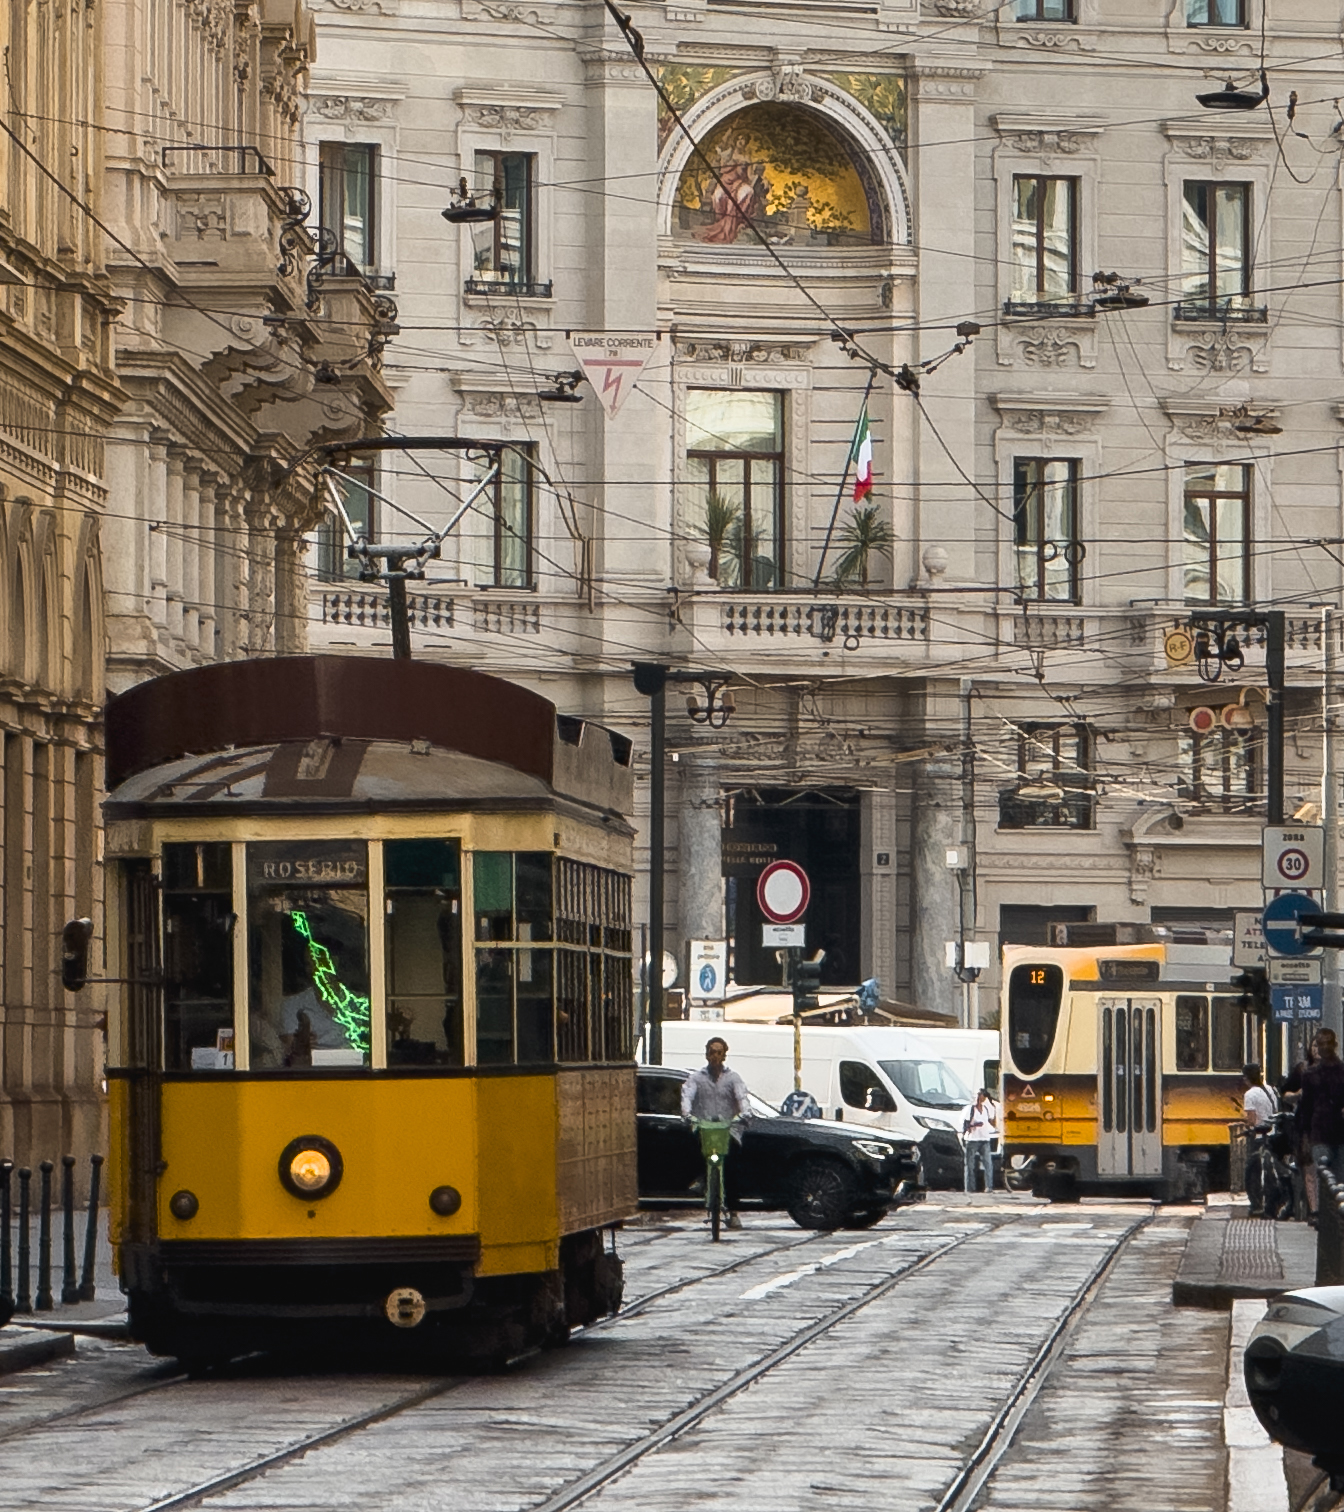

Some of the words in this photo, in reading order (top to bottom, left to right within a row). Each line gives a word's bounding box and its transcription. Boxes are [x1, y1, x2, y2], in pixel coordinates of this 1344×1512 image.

[573, 336, 606, 348] LEVARE
[606, 337, 654, 349] CORRENTE
[1285, 857, 1302, 871] 30
[1030, 970, 1046, 985] 12
